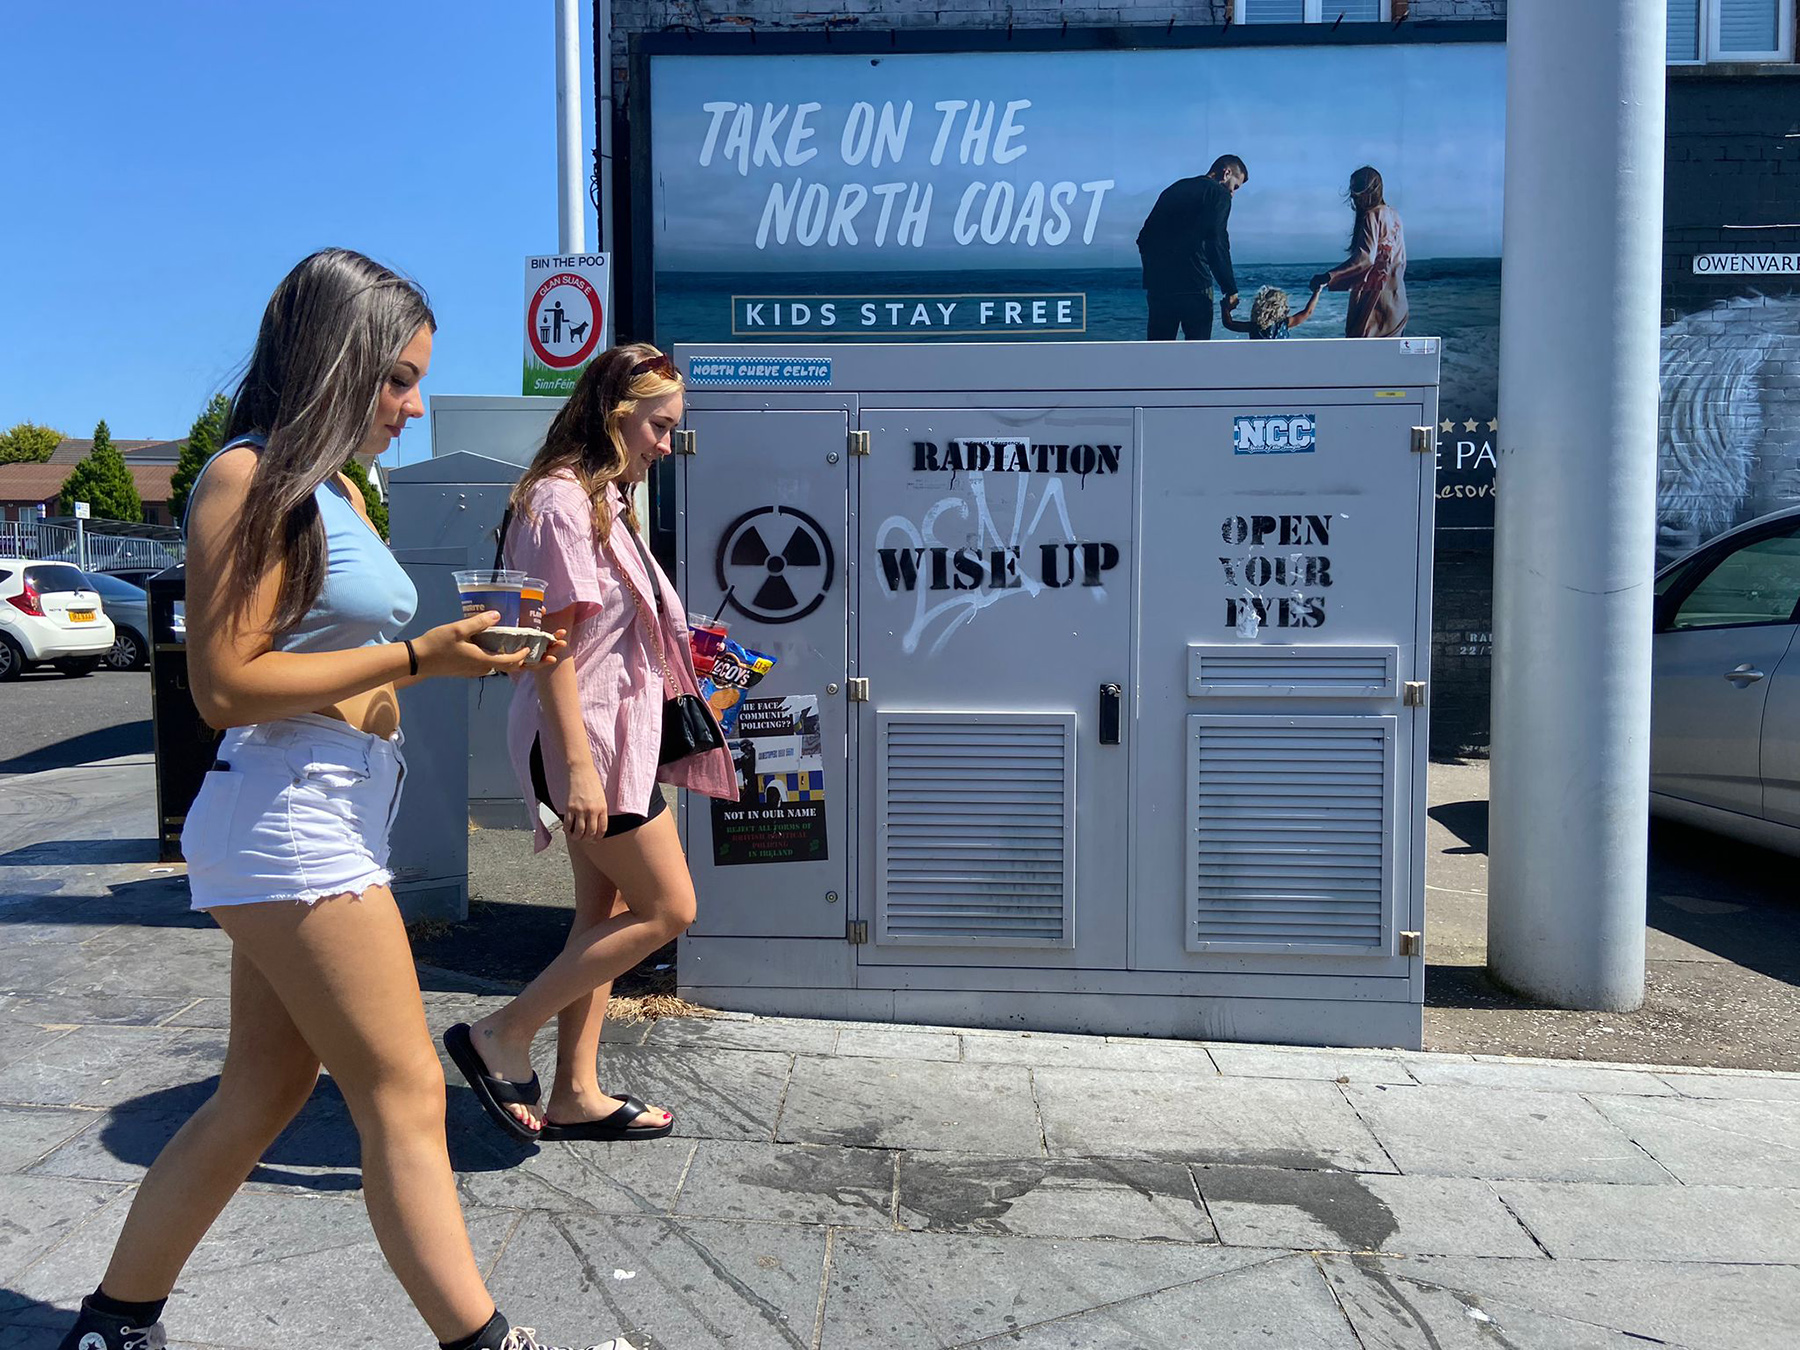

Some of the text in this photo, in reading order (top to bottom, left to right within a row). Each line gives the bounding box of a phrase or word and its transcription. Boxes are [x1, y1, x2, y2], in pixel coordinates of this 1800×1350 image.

[699, 98, 1032, 176] TAKE ON THE
[755, 176, 1115, 250] NORTH COAST
[531, 255, 605, 269] BIN THE POO
[539, 276, 561, 296] GLAN
[562, 275, 586, 290] SUAS
[746, 300, 1073, 326] KIDS STAY FREE
[692, 364, 735, 376] NORTH
[782, 364, 829, 378] CELTIC
[1237, 418, 1312, 450] NCC
[913, 440, 1122, 475] RADIATION
[1221, 514, 1333, 546] OPEN
[877, 542, 1120, 591] WISE UP
[1218, 556, 1334, 588] YOUR
[1224, 596, 1326, 629] EYES
[741, 701, 779, 712] HE FACE
[723, 807, 817, 821] NOT IN OUR NAME
